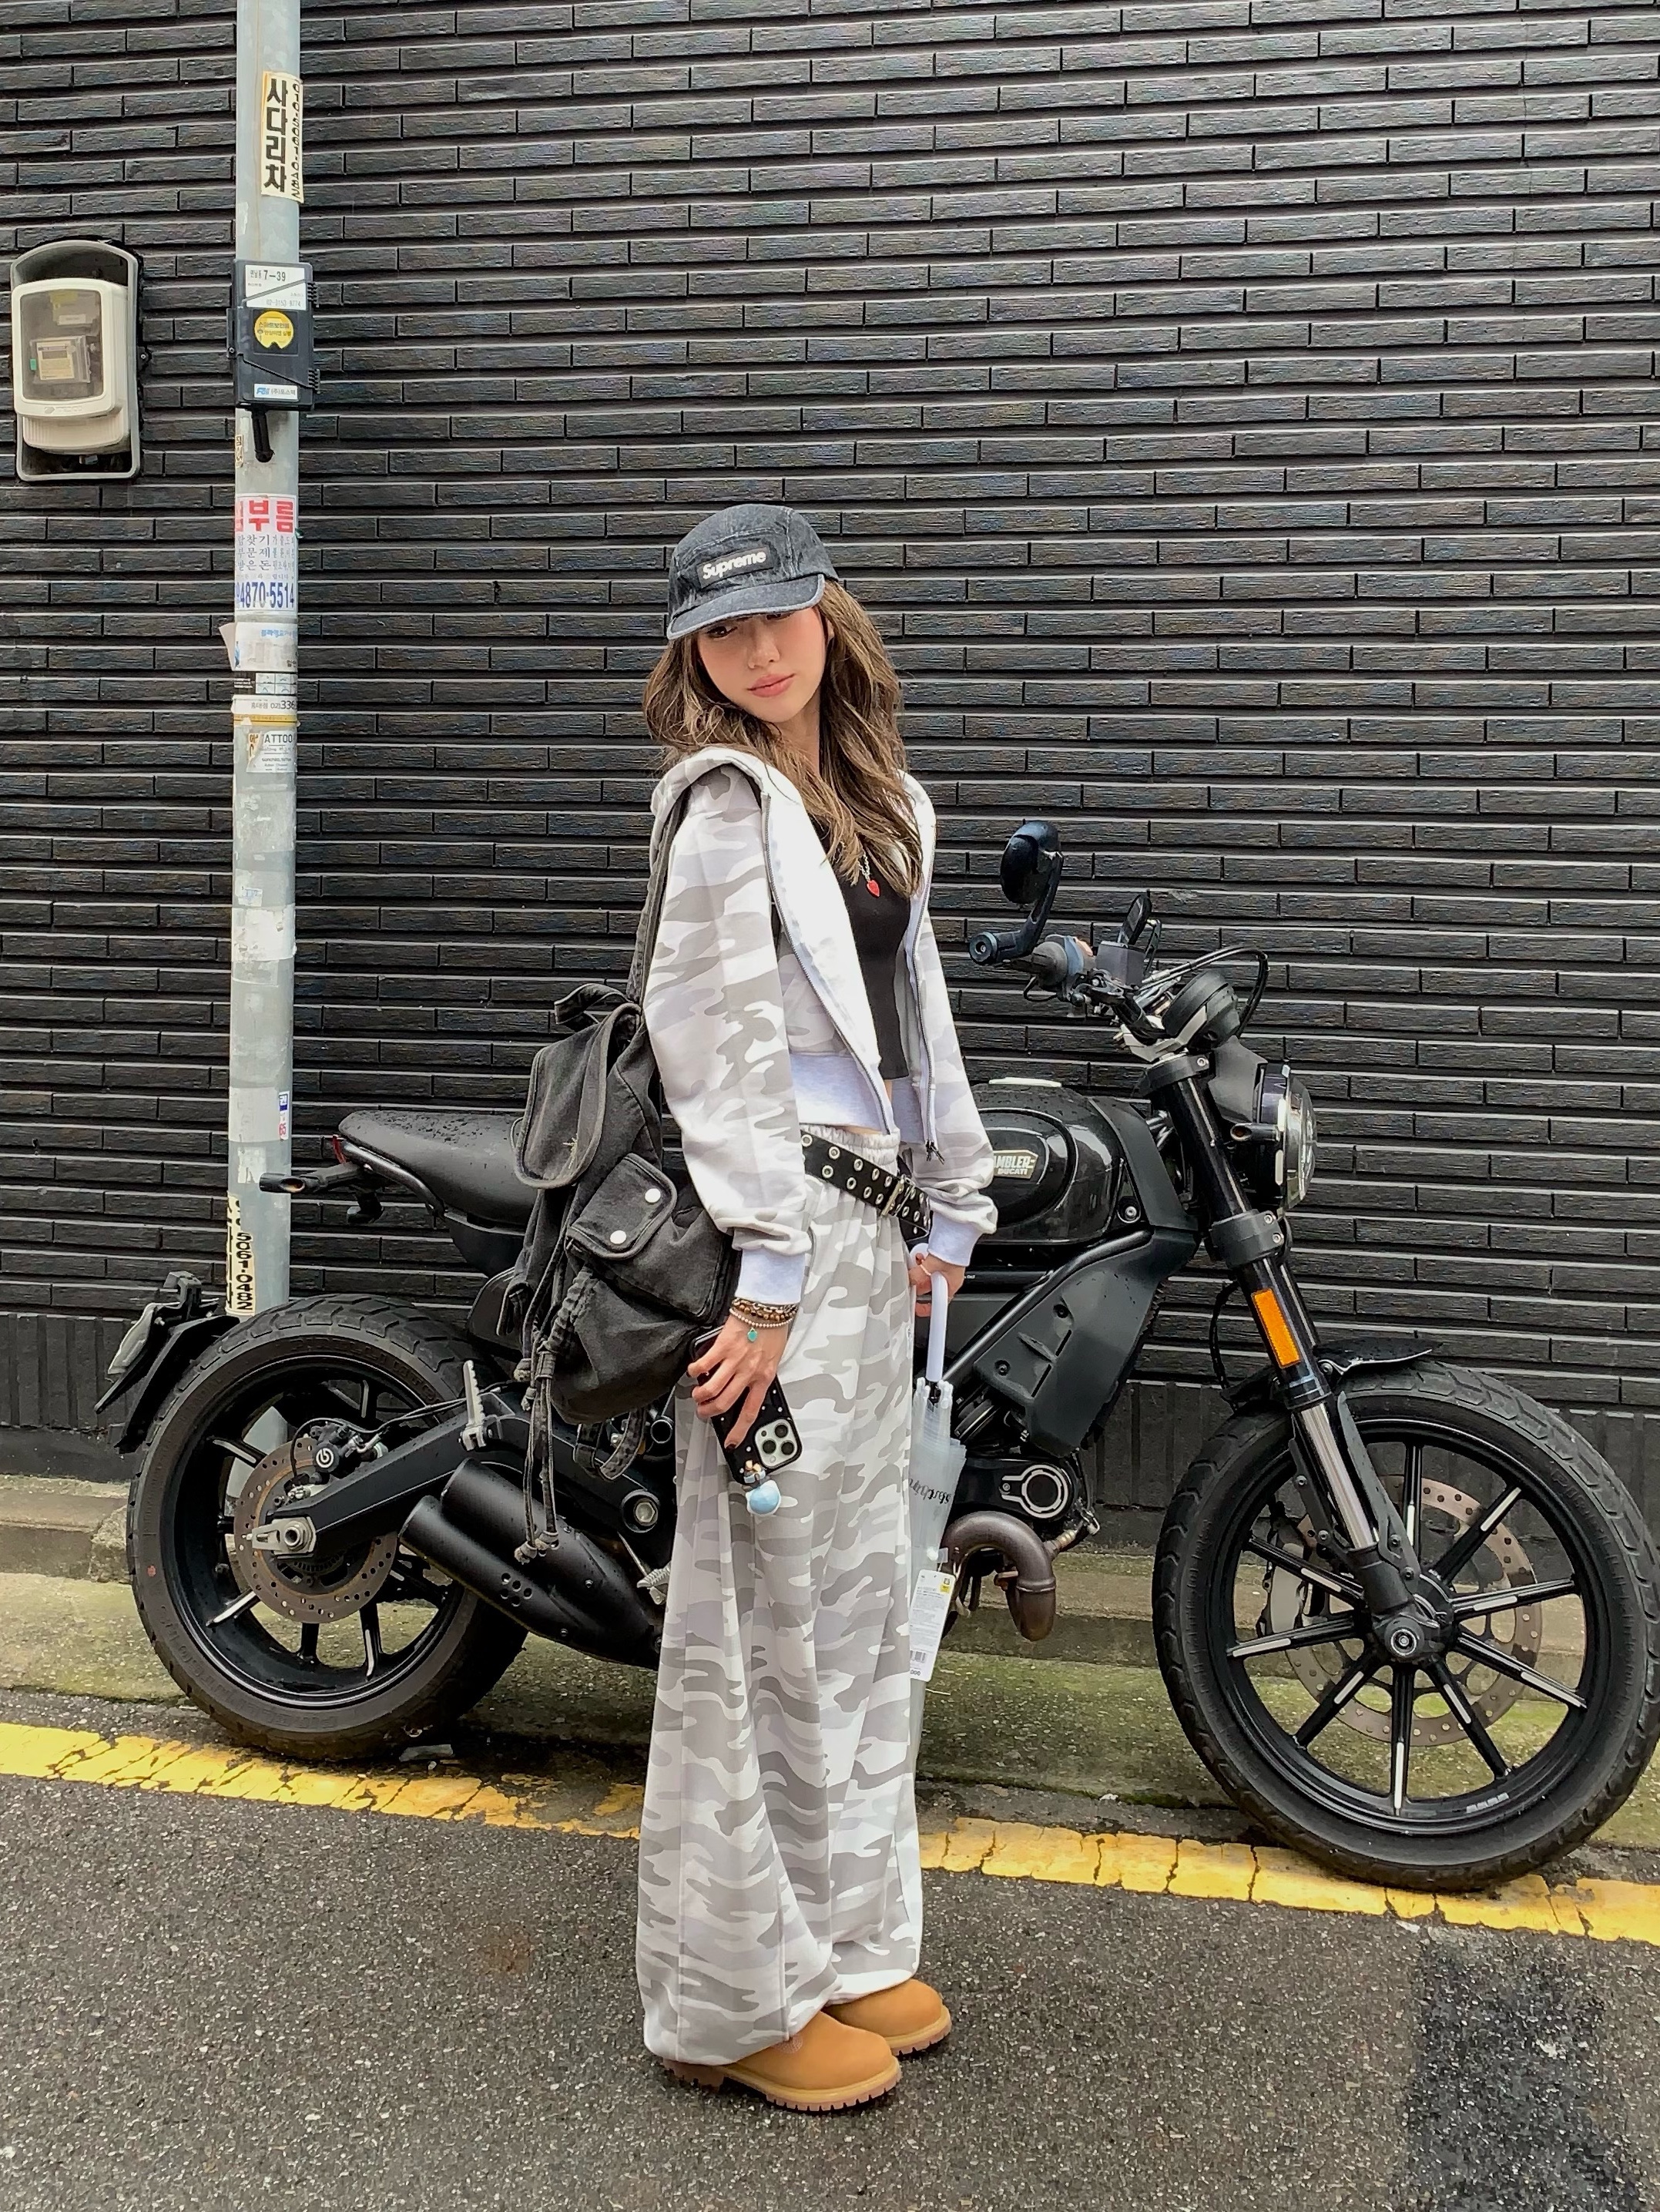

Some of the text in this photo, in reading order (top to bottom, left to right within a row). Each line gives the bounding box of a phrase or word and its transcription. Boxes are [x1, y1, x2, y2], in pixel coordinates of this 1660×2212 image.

[264, 78, 288, 193] 사다리차
[702, 551, 766, 580] Supreme
[261, 733, 293, 743] ATTOO
